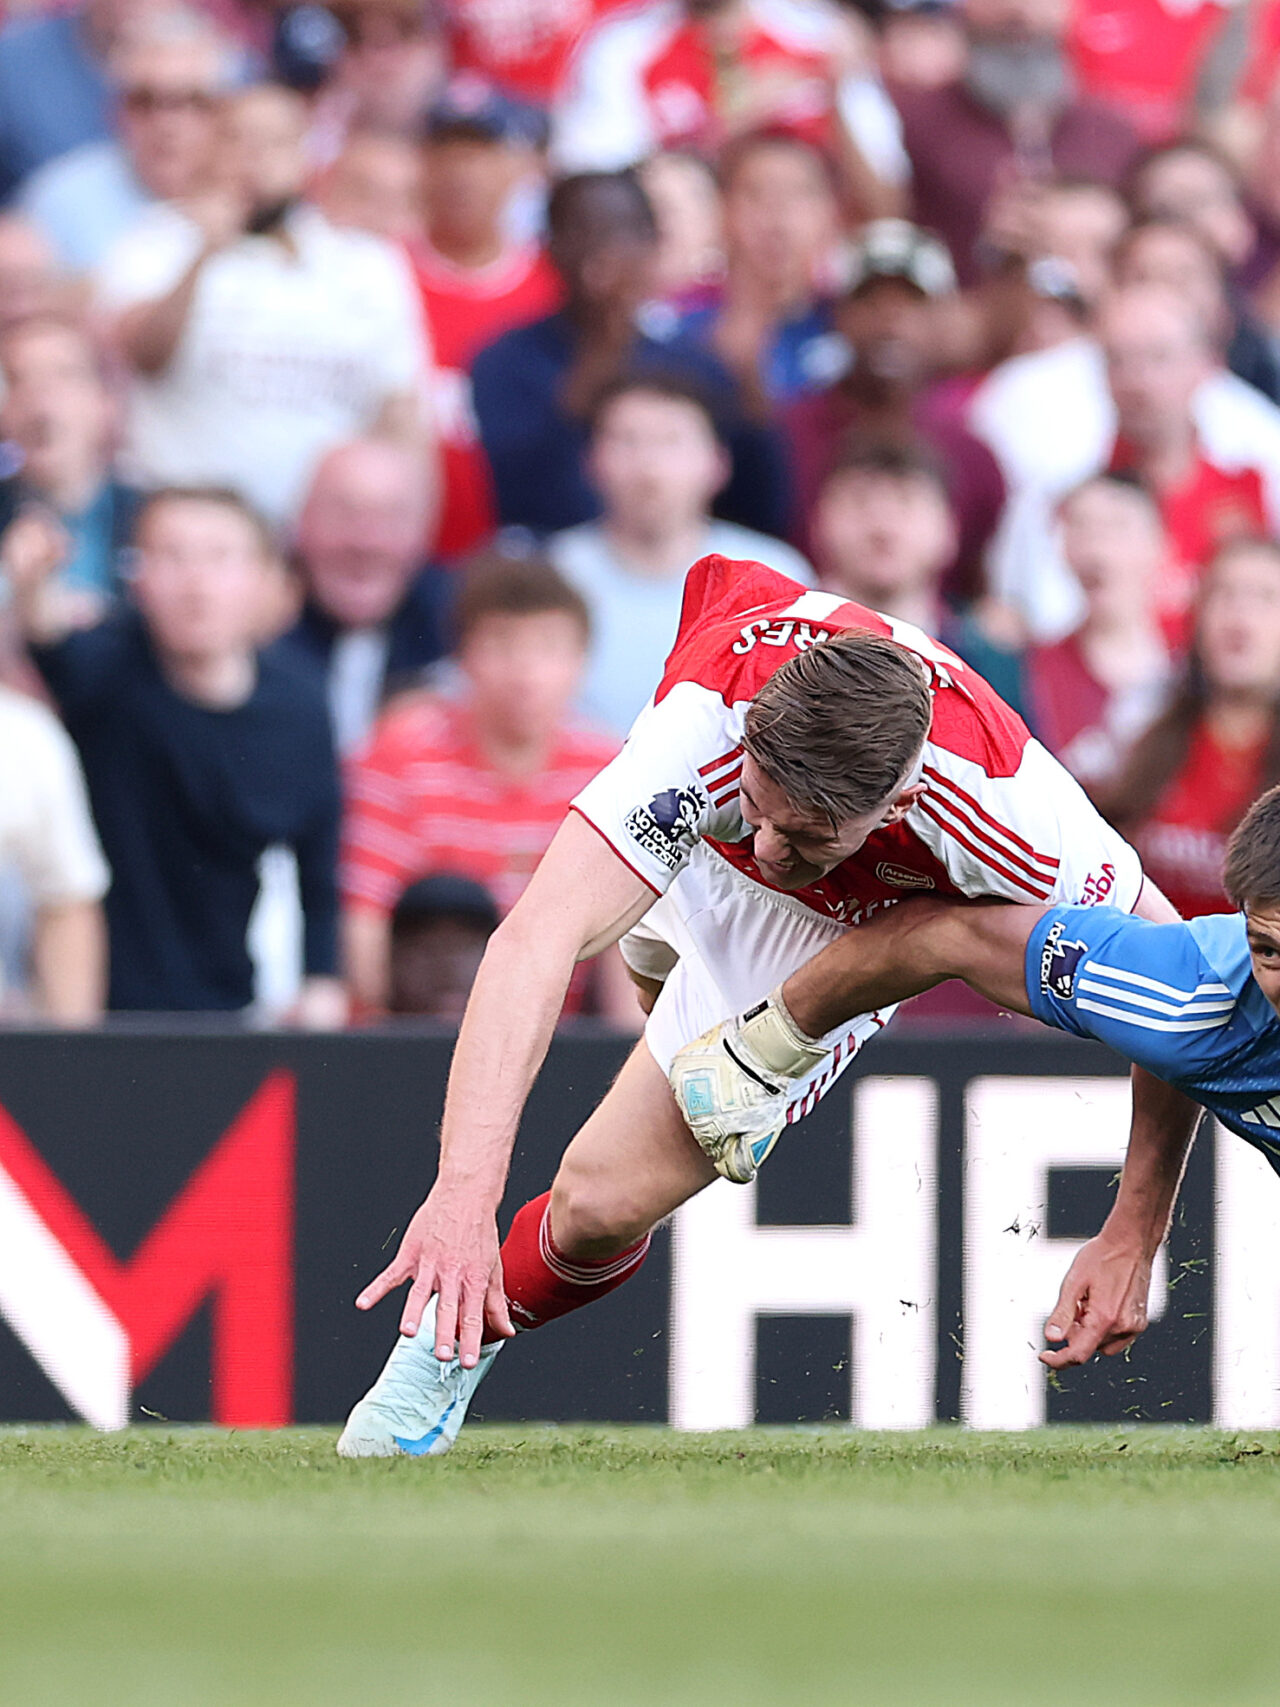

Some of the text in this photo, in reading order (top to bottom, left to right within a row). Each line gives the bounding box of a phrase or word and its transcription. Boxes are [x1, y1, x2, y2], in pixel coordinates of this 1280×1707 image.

[732, 618, 830, 654] RES
[628, 807, 651, 830] No
[640, 834, 678, 869] racism
[885, 867, 928, 883] Arsenal
